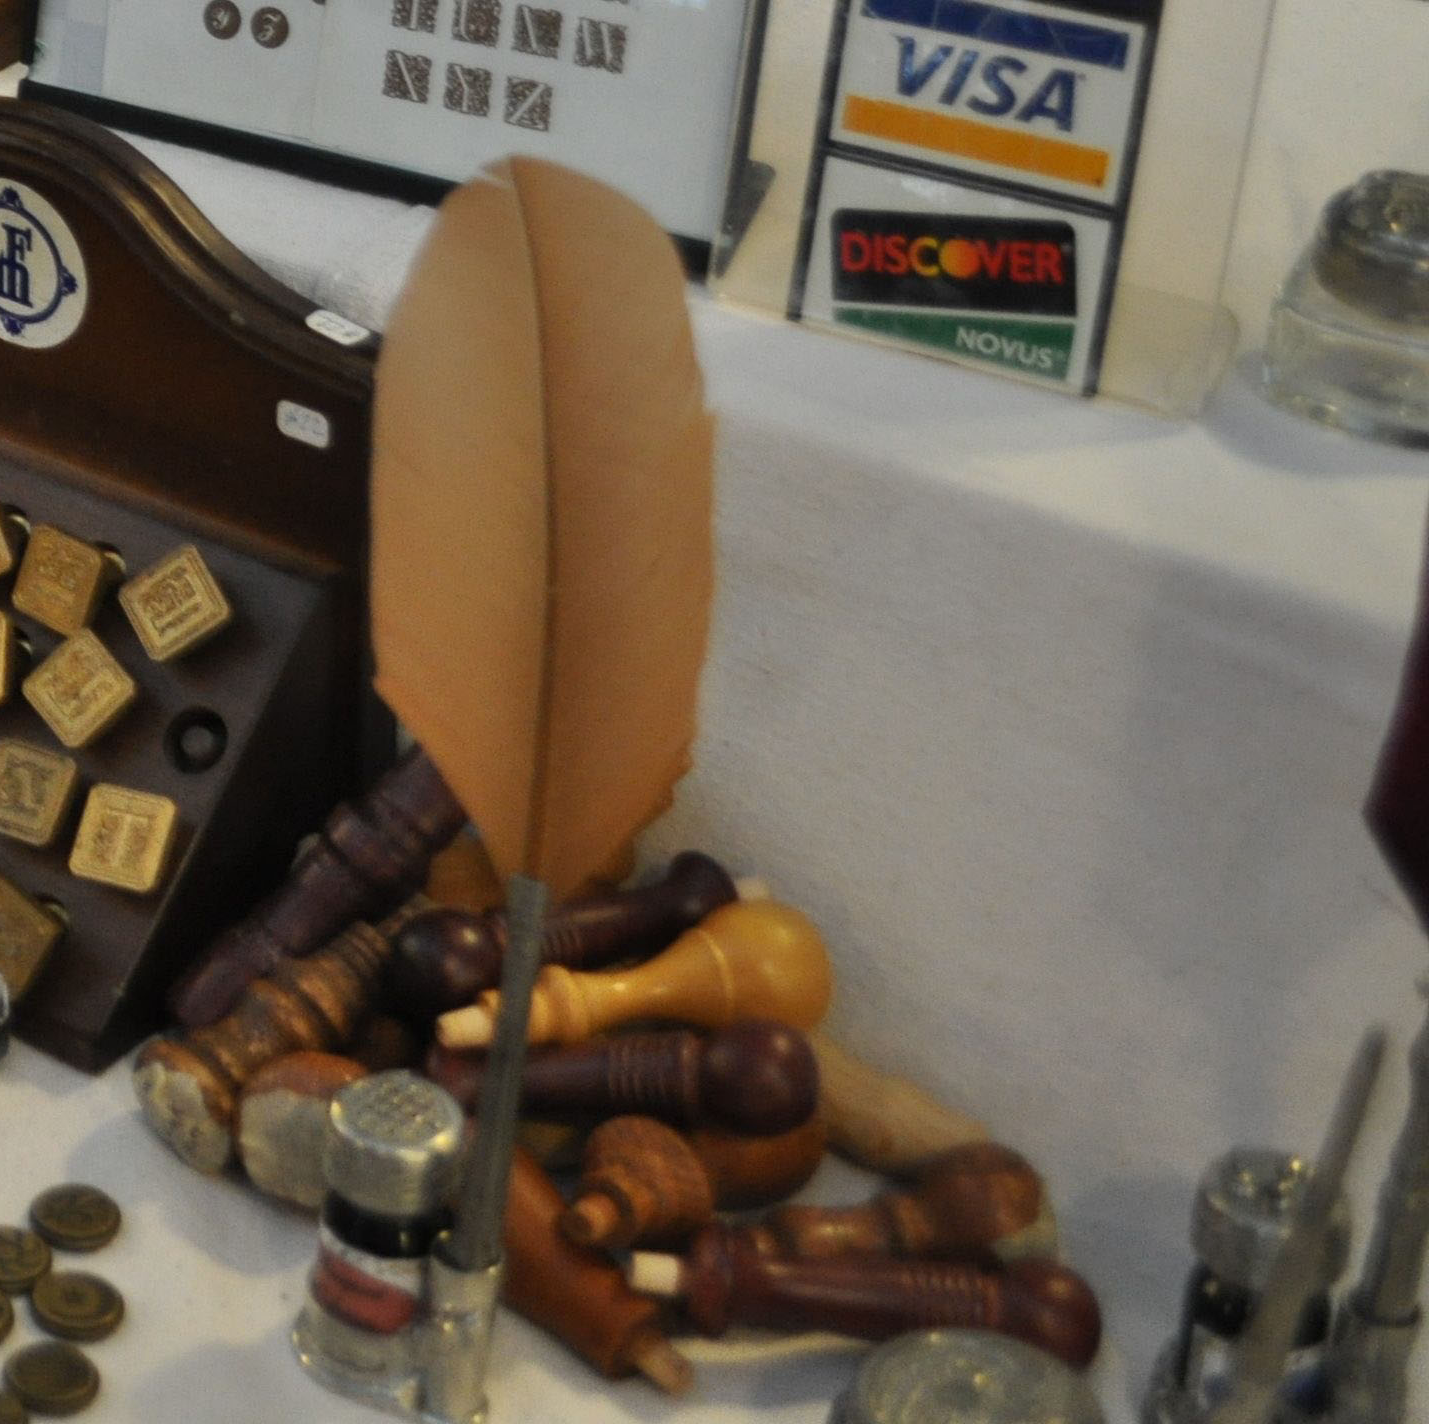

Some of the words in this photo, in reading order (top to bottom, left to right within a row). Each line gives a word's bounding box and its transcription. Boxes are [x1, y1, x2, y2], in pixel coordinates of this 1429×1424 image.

[895, 35, 1077, 133] VISA
[841, 229, 1064, 285] DISCOVER
[956, 326, 1054, 369] NOVUS
